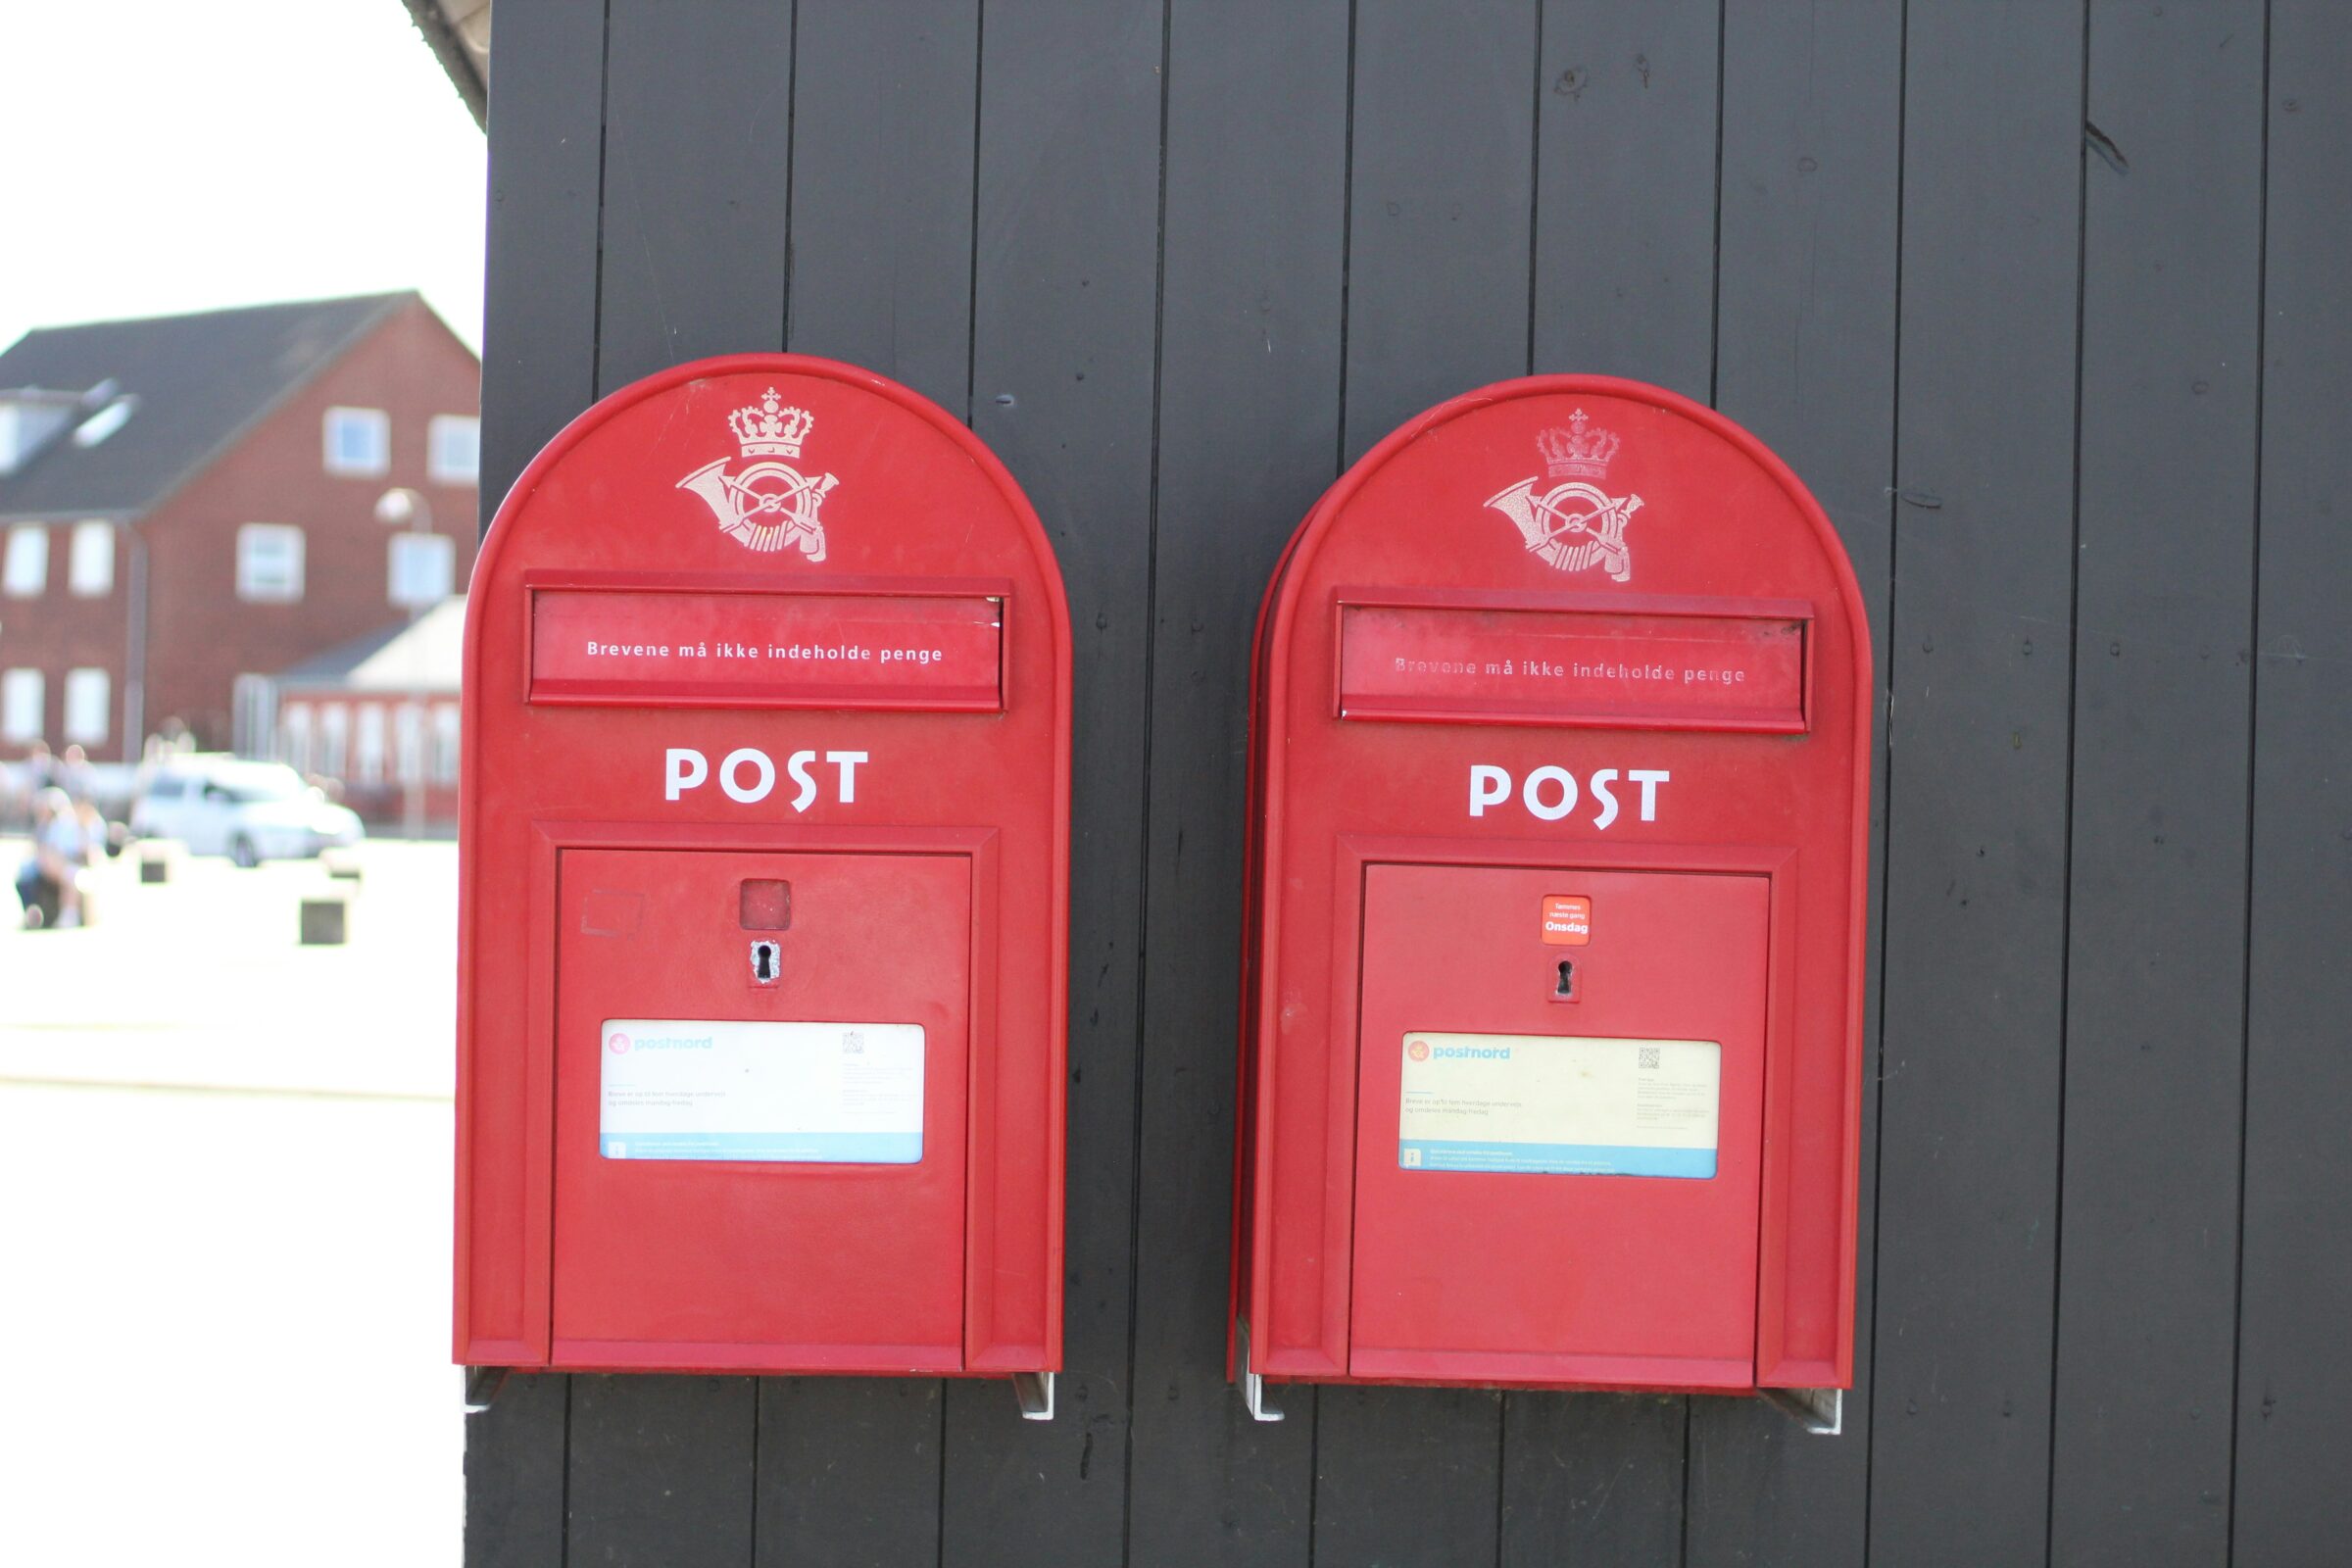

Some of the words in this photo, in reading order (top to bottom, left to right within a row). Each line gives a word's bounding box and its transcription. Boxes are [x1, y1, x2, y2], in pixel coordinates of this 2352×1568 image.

[588, 641, 669, 657] Brevene
[679, 642, 707, 658] må
[717, 643, 759, 659] ikke
[768, 644, 870, 660] indeholde
[881, 649, 942, 663] penge
[1396, 658, 1476, 674] Brevene
[1486, 660, 1514, 675] må
[1523, 662, 1564, 676] ikke
[1574, 662, 1675, 680] indeholde
[1684, 668, 1745, 685] penge
[665, 748, 868, 812] POST
[1470, 765, 1670, 830] POST
[1545, 921, 1589, 935] Onsdag
[634, 1036, 712, 1052] postnord
[1434, 1046, 1511, 1059] postnord
